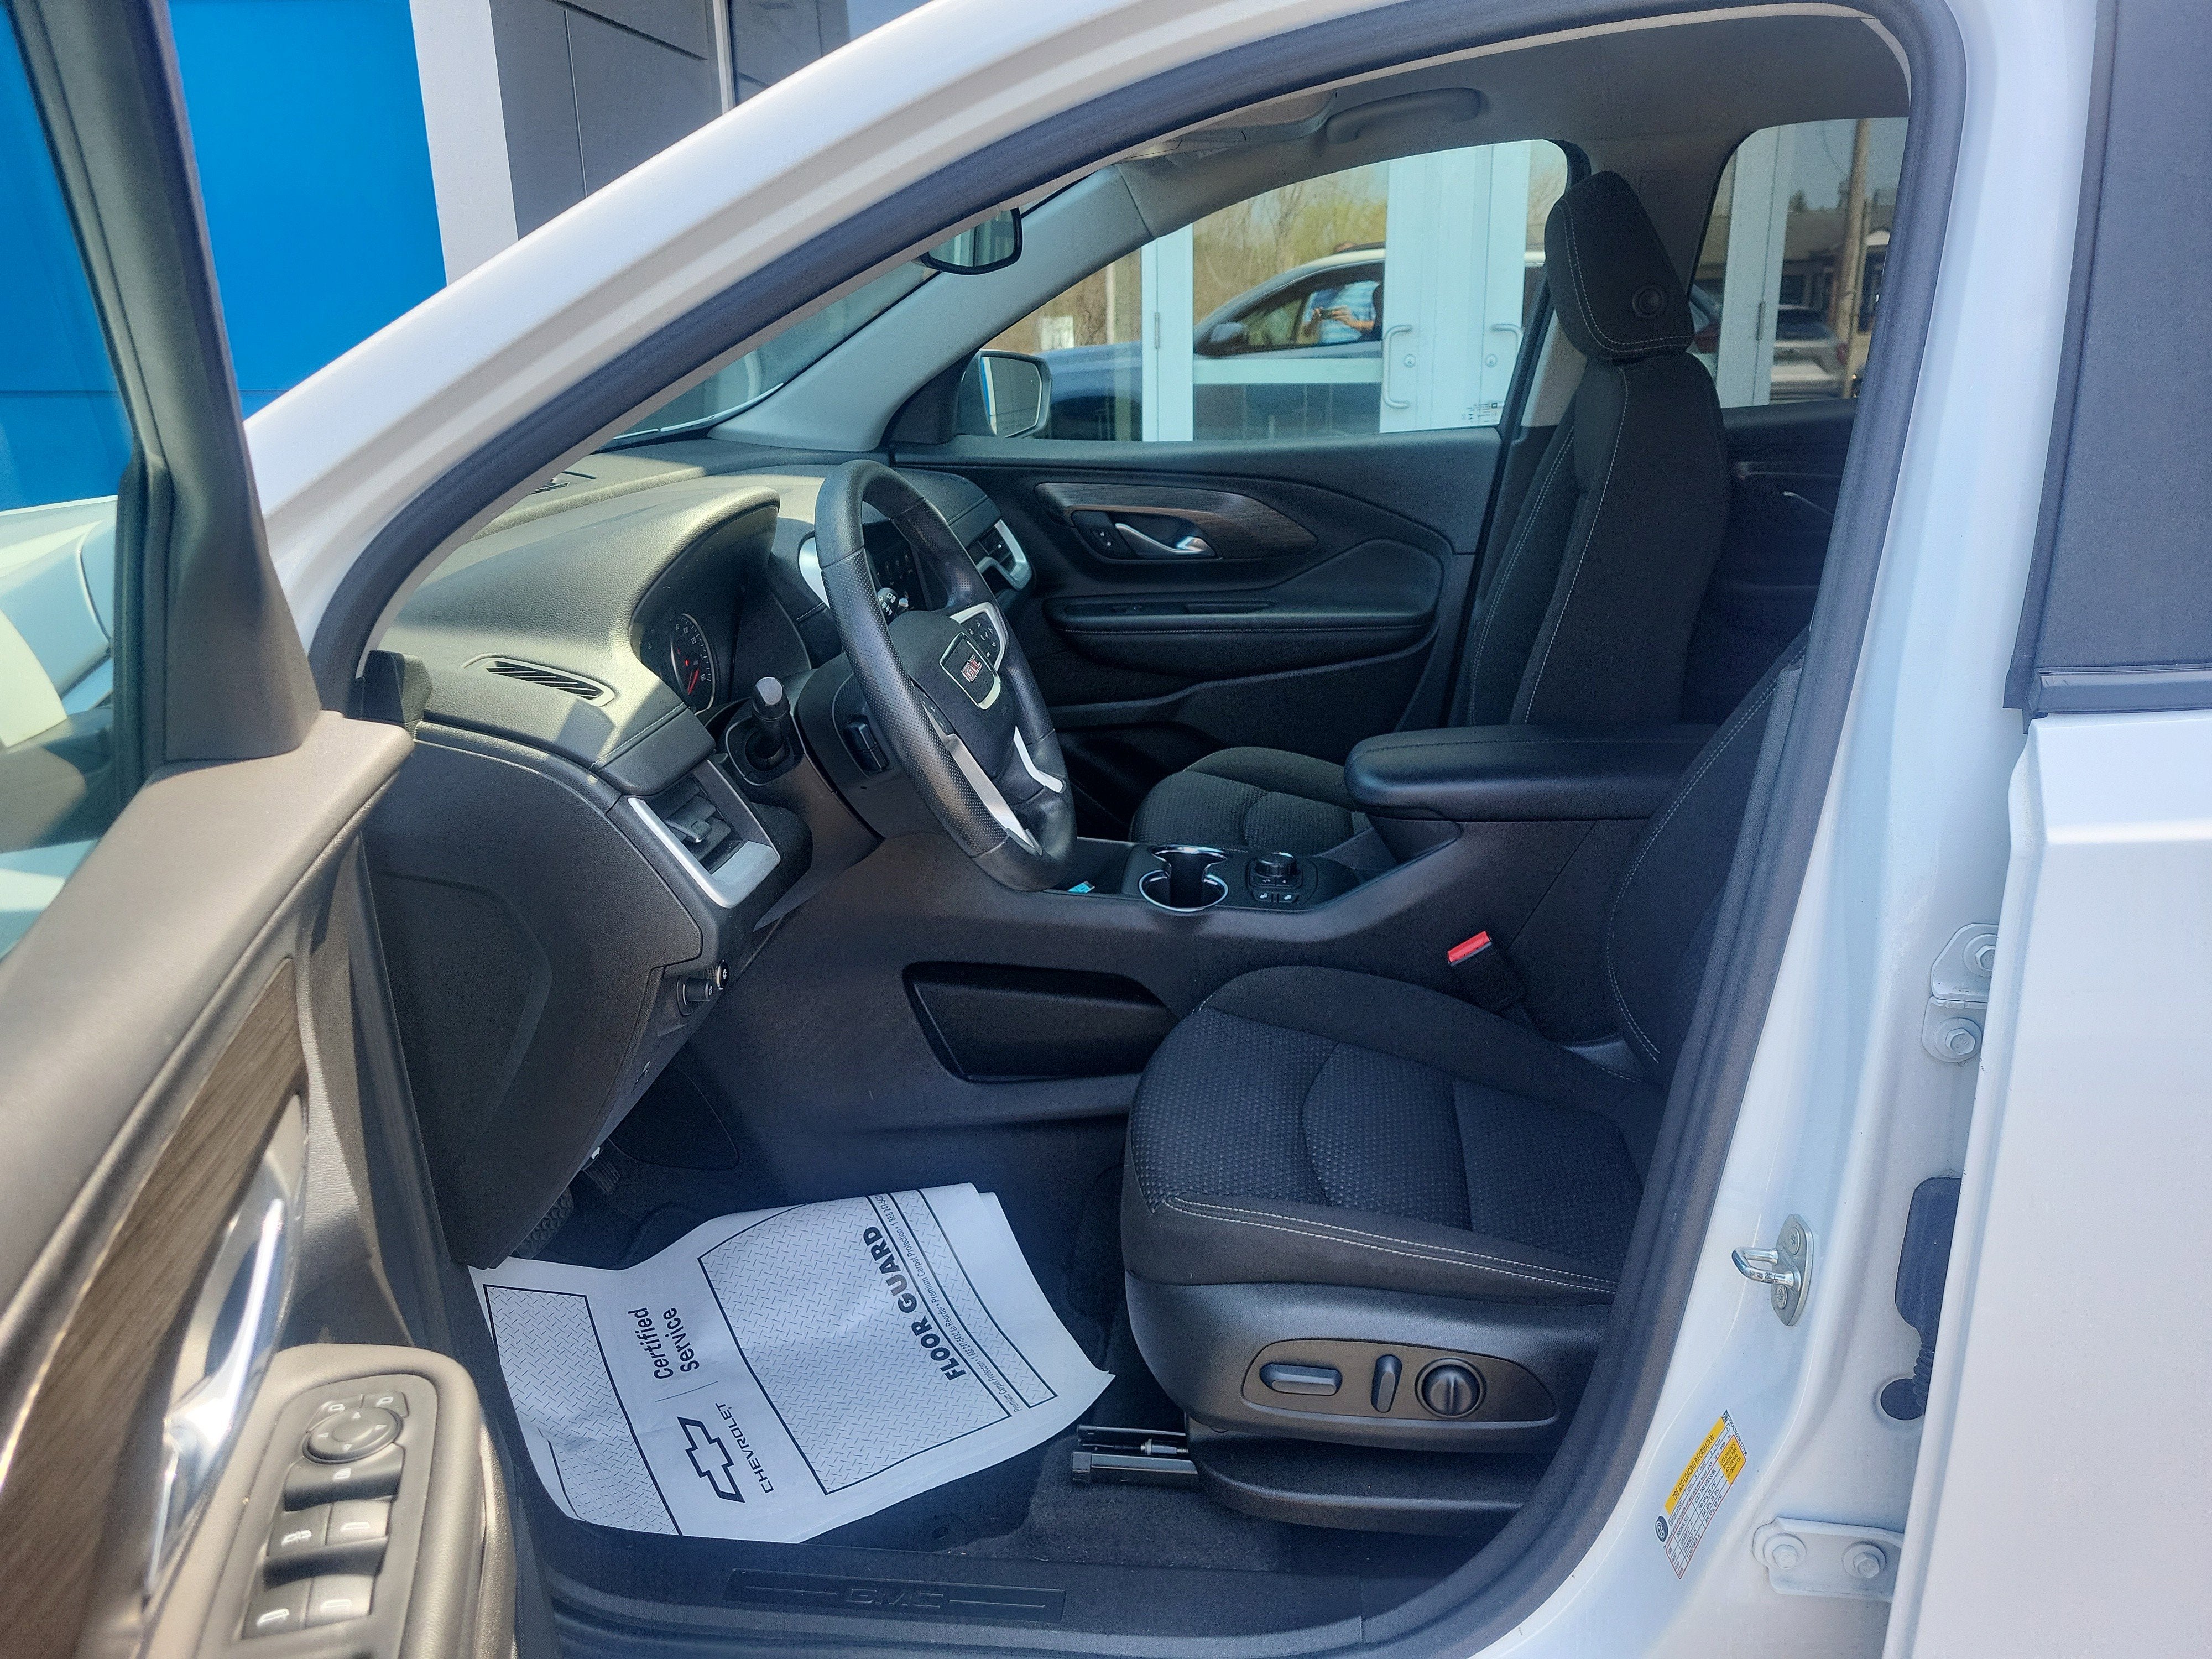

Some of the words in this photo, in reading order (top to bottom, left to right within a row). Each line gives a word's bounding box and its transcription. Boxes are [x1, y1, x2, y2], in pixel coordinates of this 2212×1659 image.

[961, 654, 983, 682] GMC
[885, 1212, 896, 1222] 888
[896, 1228, 916, 1258] Protection
[863, 1227, 917, 1313] GUARD
[910, 1257, 925, 1277] Carpet
[922, 1277, 940, 1303] Premium
[937, 1306, 954, 1327] Reorder
[628, 1307, 674, 1379] Certified
[663, 1308, 700, 1373] Service
[911, 1316, 967, 1381] FLOOR
[977, 1360, 998, 1384] Protection
[994, 1380, 1008, 1395] Carpet
[1004, 1394, 1023, 1412] Premium
[715, 1402, 774, 1494] CHEVROLET
[1724, 1441, 1735, 1459] OWNER'S
[1671, 1486, 1679, 1502] TIRE
[1677, 1477, 1685, 1492] AND
[1682, 1458, 1697, 1484] LOADING
[1694, 1432, 1714, 1465] INFORMATION
[1722, 1453, 1732, 1470] MANUAL
[1725, 1451, 1739, 1473] ADDITIONAL
[1726, 1454, 1741, 1479] INFORMATION
[1703, 1467, 1717, 1488] PRESSURE
[846, 1588, 944, 1609] GMC
